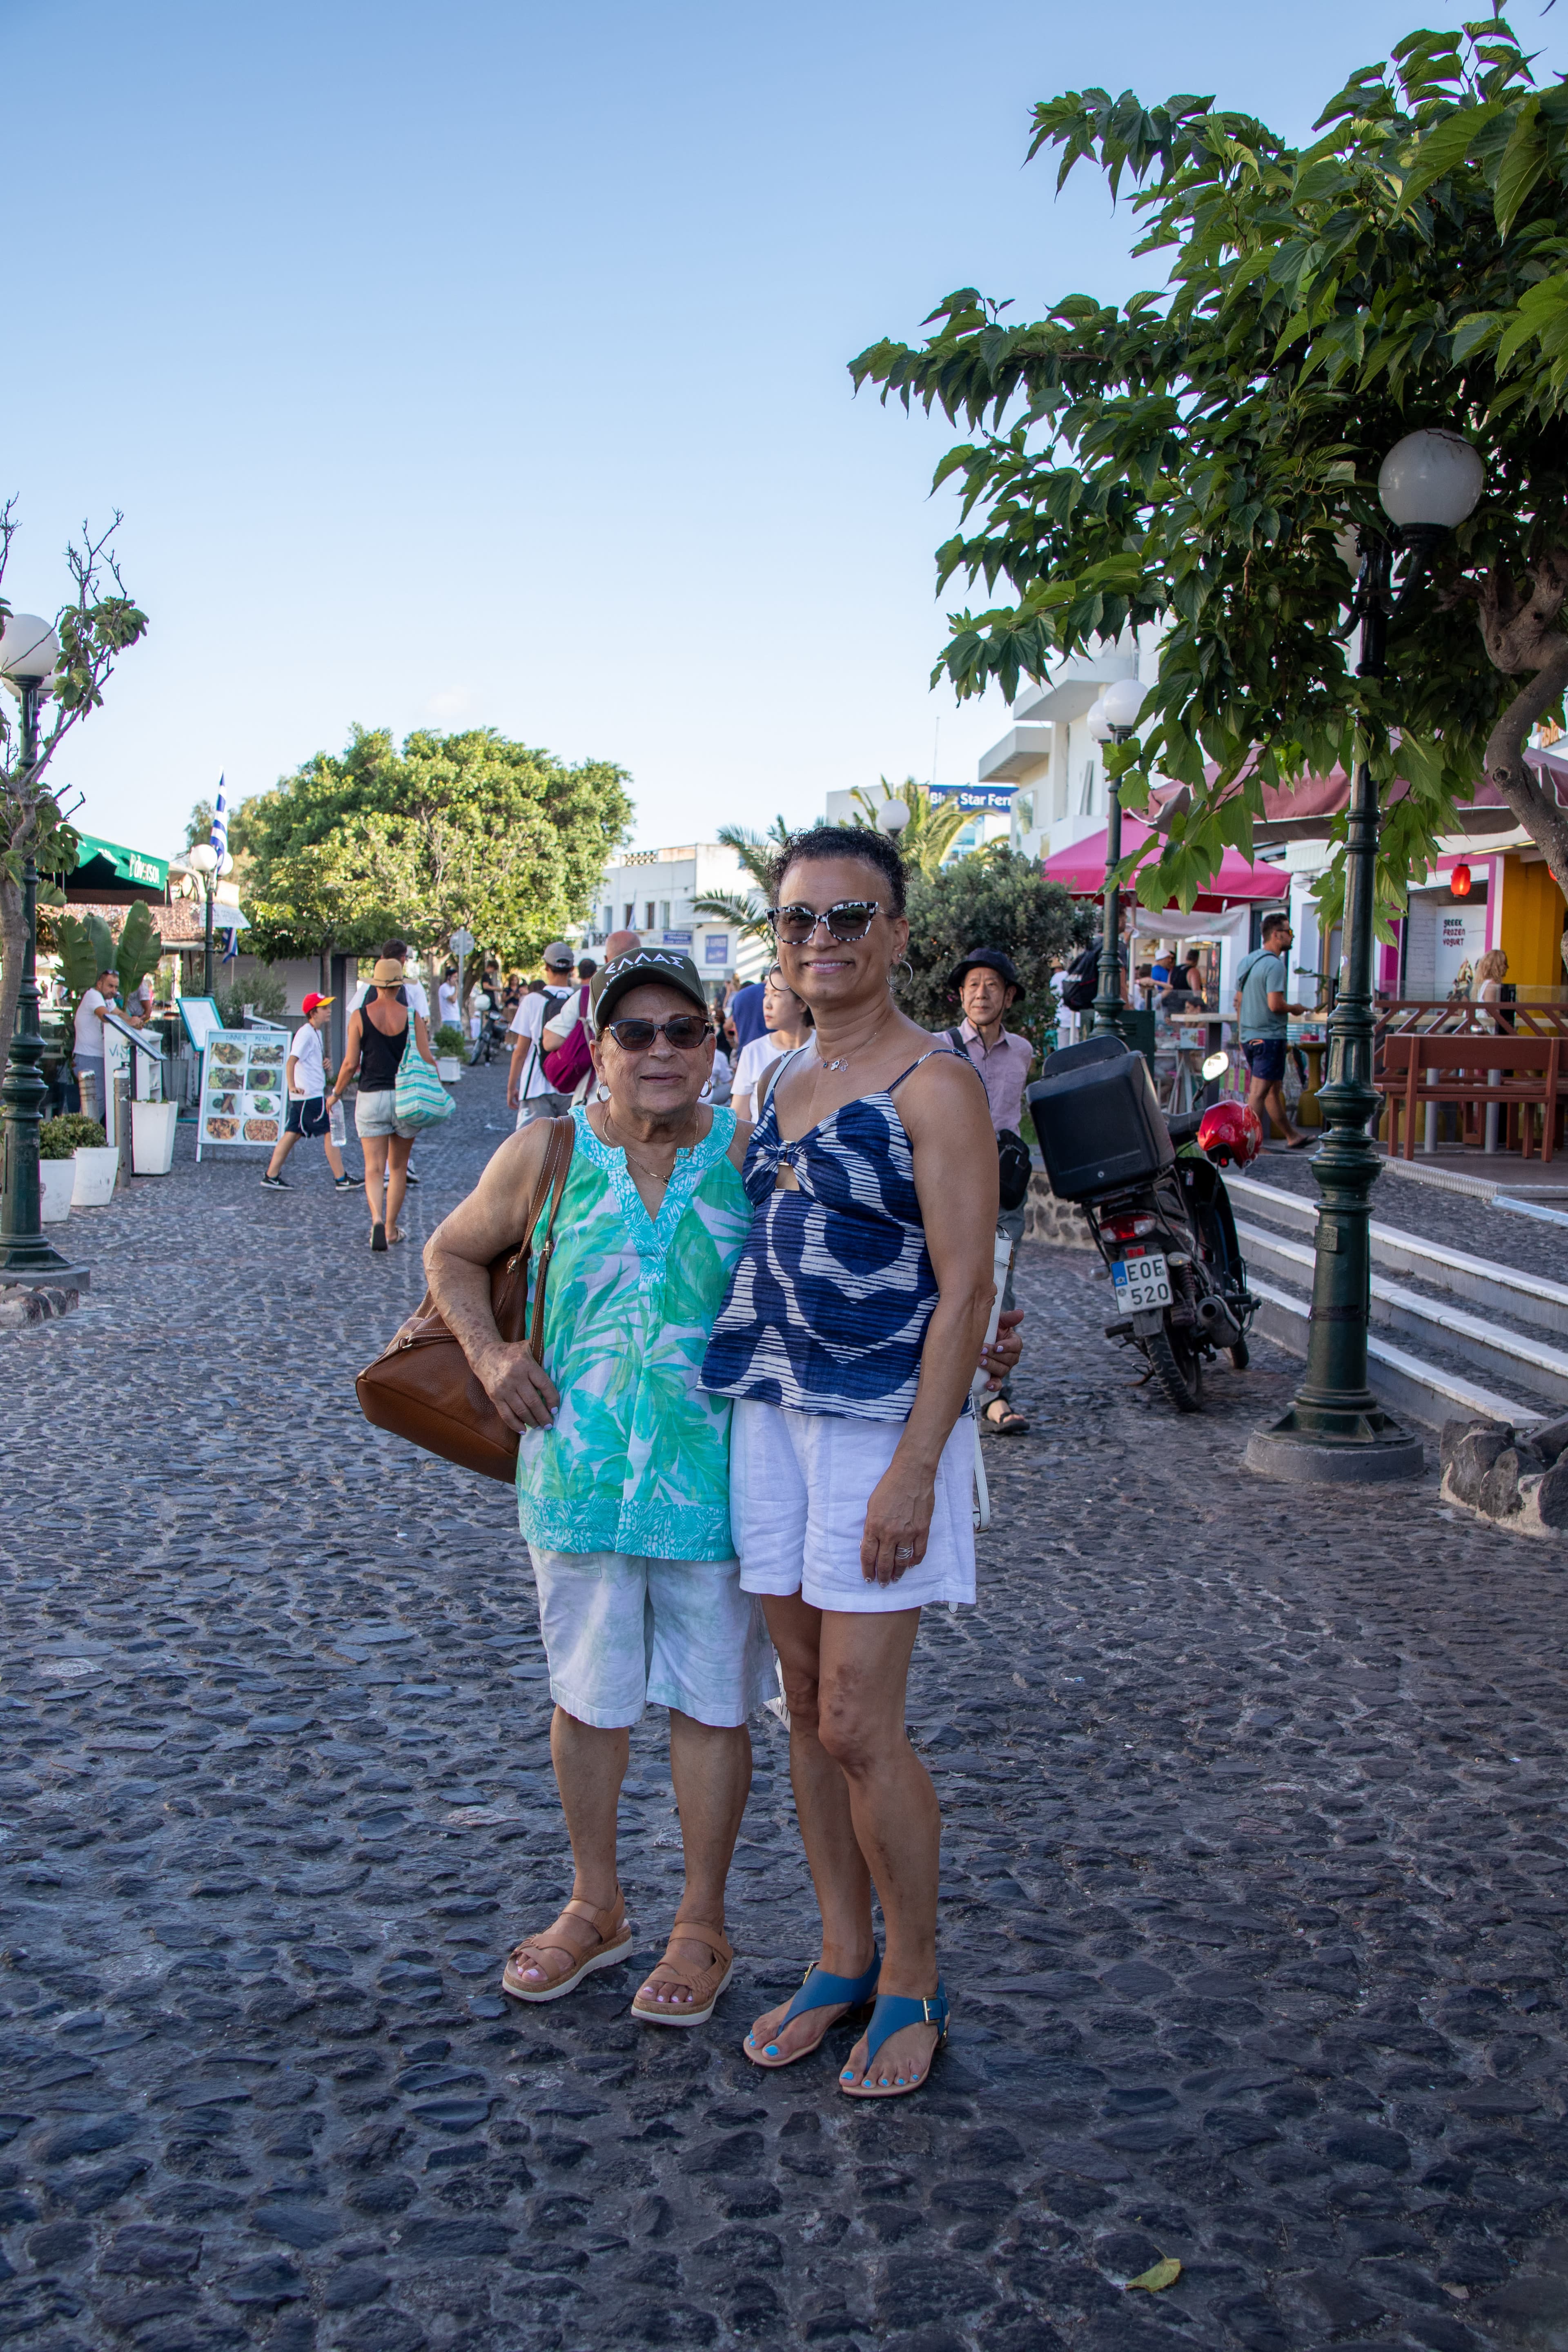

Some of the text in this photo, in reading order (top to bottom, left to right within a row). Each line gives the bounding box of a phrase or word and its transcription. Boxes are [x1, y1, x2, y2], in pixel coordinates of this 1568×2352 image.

[960, 793, 986, 806] Star
[988, 794, 1011, 806] Ferr
[1131, 1283, 1169, 1305] 520
